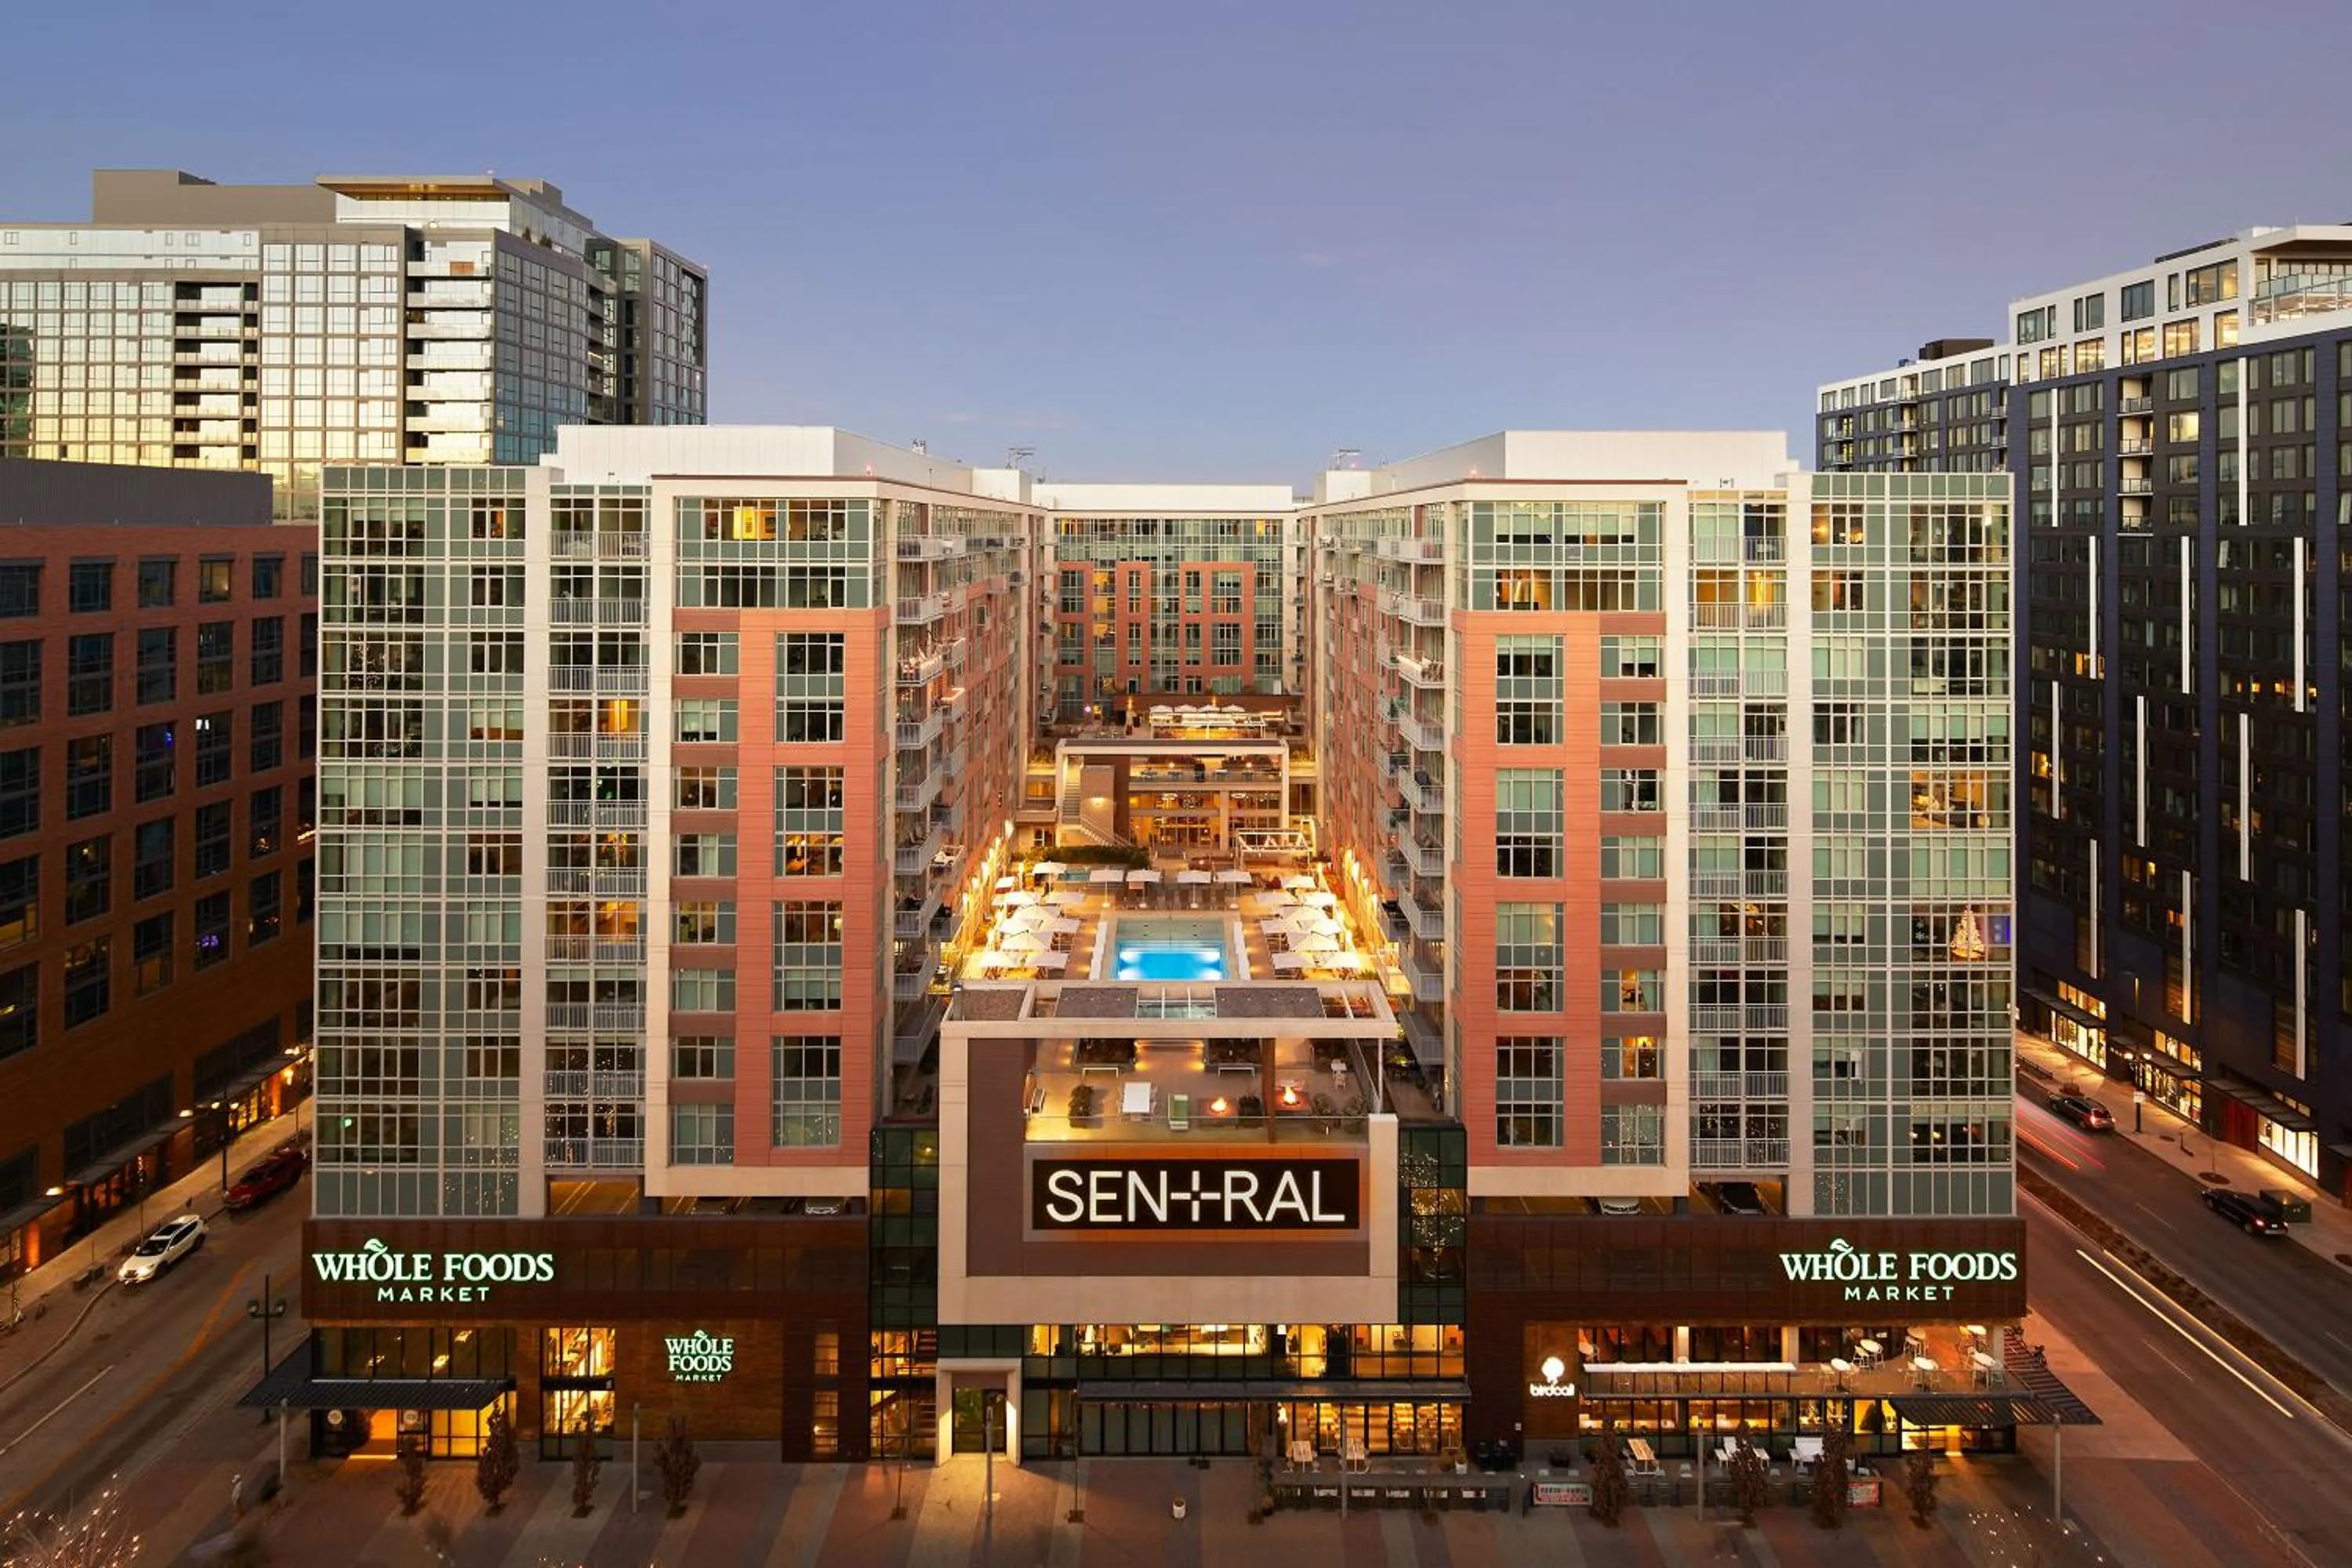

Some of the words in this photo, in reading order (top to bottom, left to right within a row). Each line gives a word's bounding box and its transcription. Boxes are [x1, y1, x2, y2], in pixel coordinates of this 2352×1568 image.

[312, 1252, 432, 1281] WHOLE
[443, 1253, 554, 1281] FOODS
[1780, 1252, 1898, 1281] WHOLE
[1909, 1252, 2017, 1280] FOODS
[377, 1287, 490, 1302] MARKET
[1844, 1286, 1955, 1301] MARKET
[665, 1338, 734, 1356] WHOLE
[669, 1355, 732, 1372] FOODS
[675, 1374, 722, 1382] MARKET
